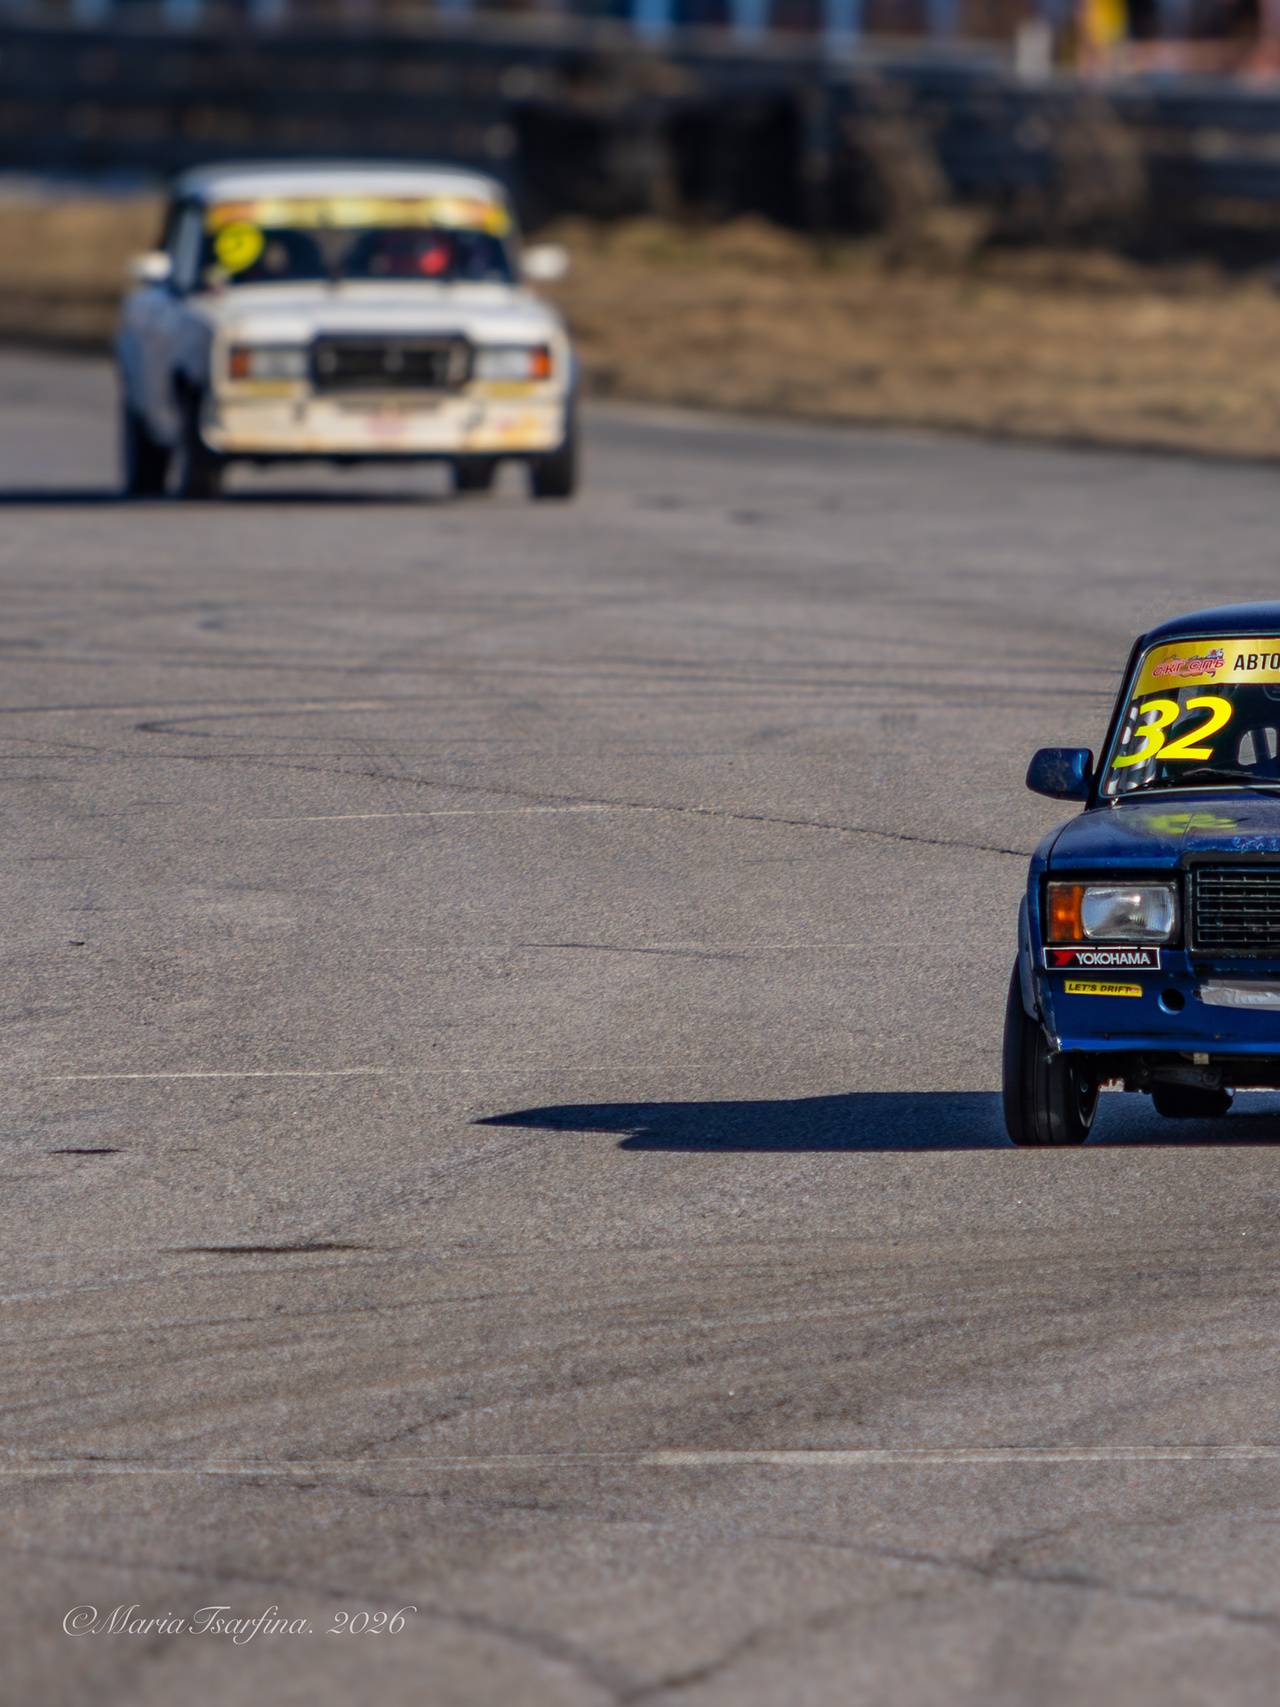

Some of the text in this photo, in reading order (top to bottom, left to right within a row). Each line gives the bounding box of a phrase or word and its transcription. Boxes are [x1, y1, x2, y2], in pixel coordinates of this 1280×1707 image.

[1111, 696, 1232, 768] 32
[1076, 952, 1150, 965] YOKOHAMA
[1068, 983, 1097, 992] LET'S
